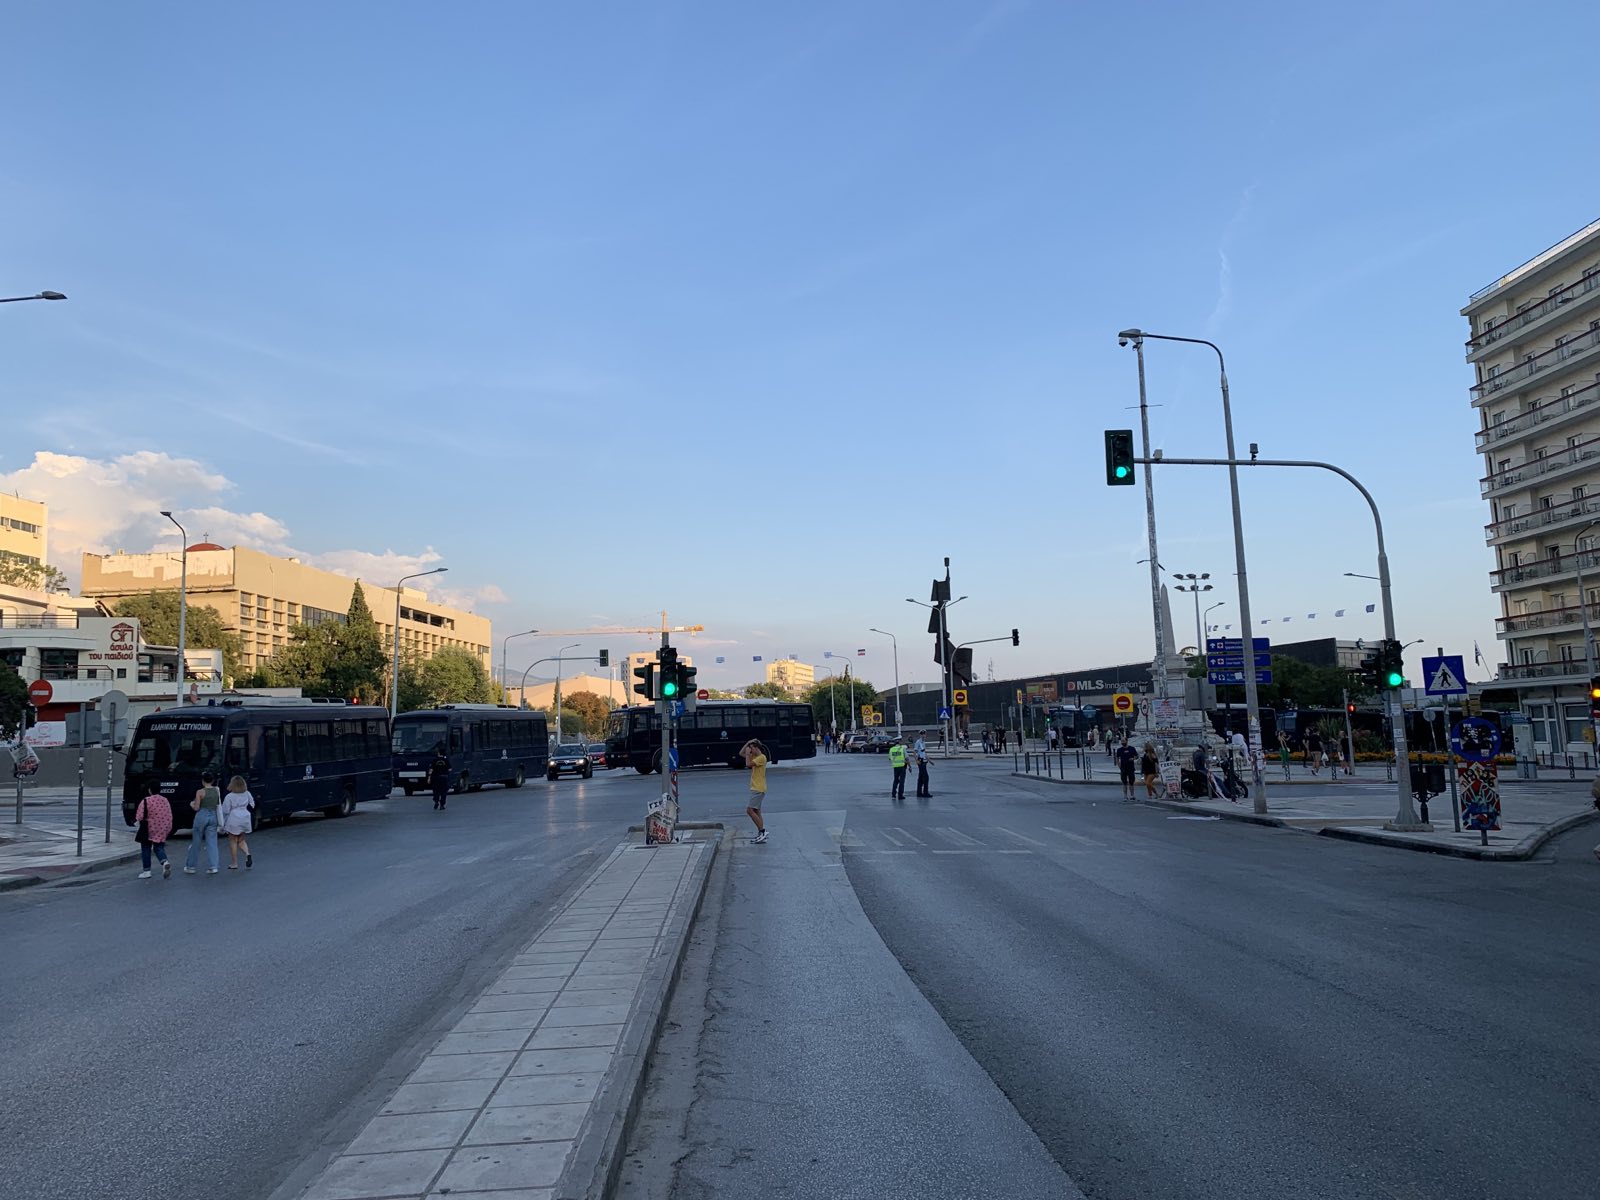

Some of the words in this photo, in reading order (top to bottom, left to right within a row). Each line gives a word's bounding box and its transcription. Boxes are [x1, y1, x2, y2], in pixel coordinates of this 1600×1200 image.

[110, 643, 134, 651] άσυλο
[104, 652, 134, 660] παιδιού
[1076, 680, 1104, 690] MLS
[179, 723, 212, 731] ΑΣΤΥΝΟΜΙΑ
